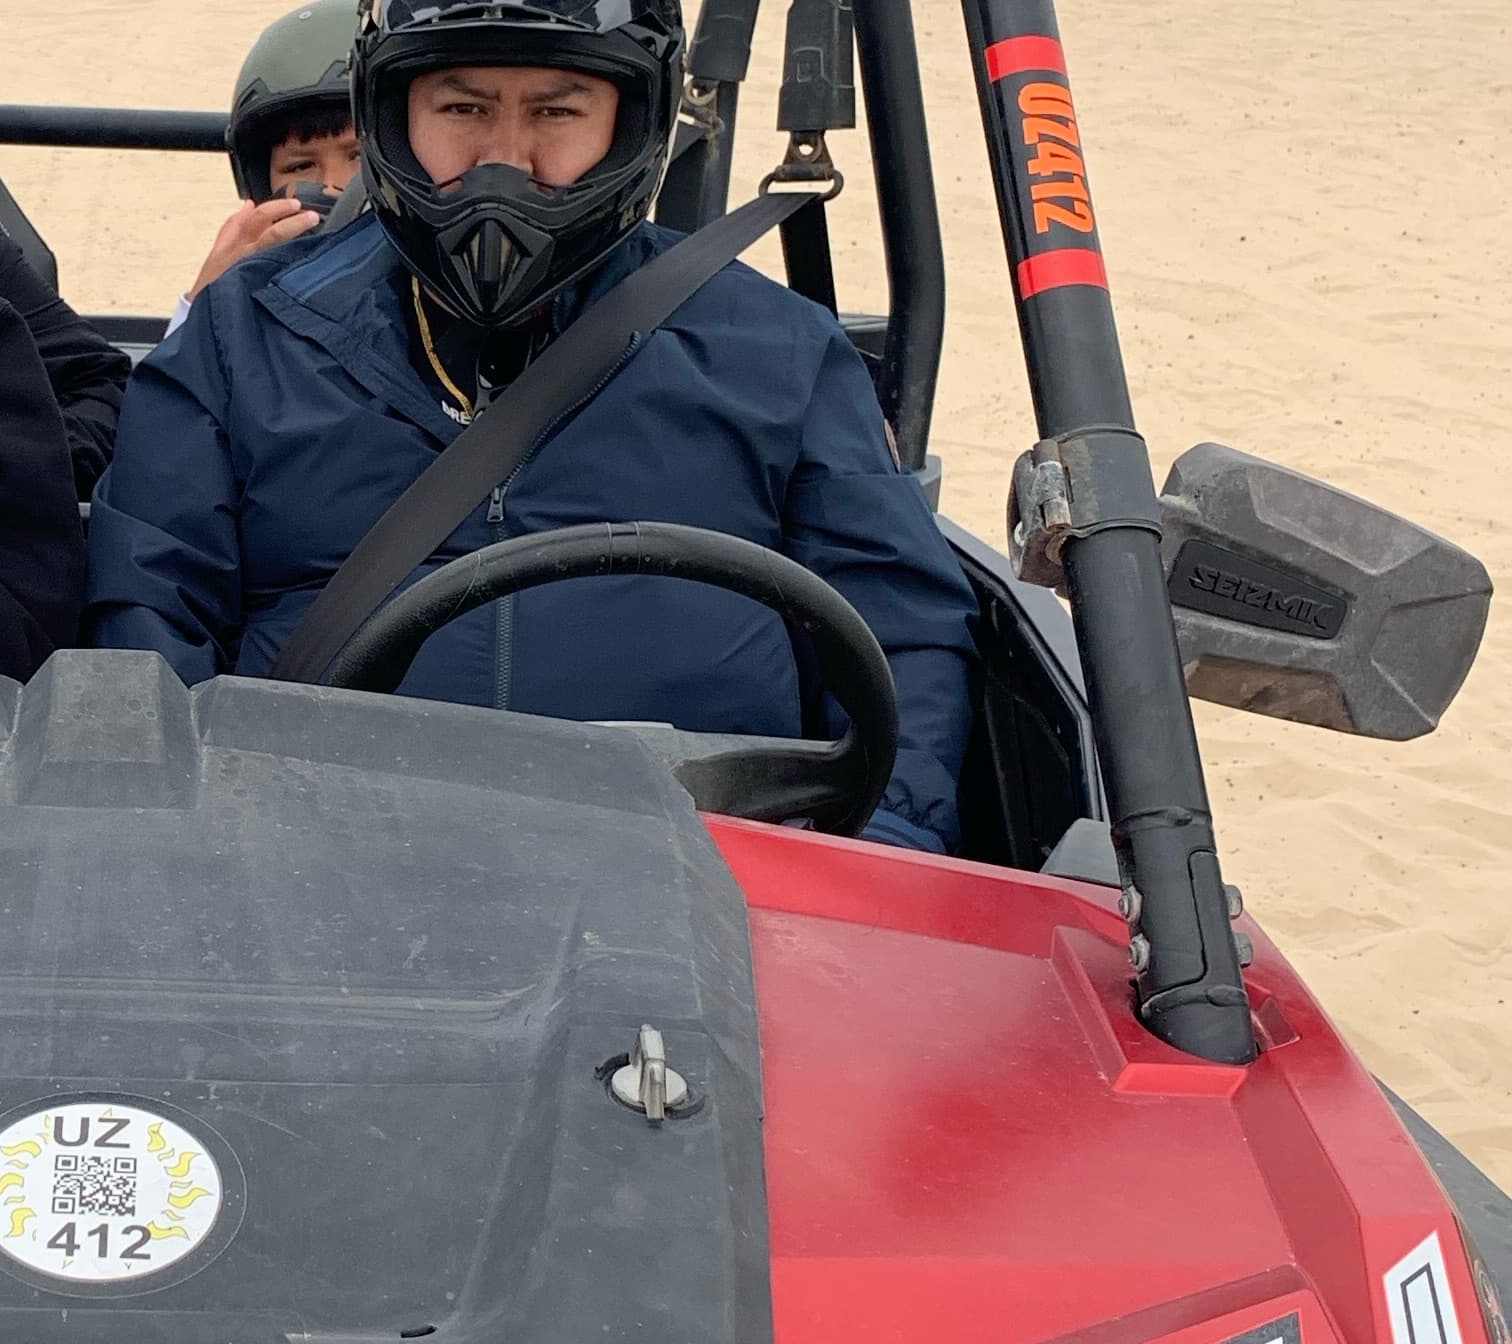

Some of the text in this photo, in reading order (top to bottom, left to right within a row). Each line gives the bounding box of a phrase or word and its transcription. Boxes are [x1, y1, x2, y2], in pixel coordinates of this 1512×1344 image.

[1018, 82, 1095, 234] UZ412
[53, 1116, 131, 1149] UZ
[46, 1221, 151, 1260] 412
